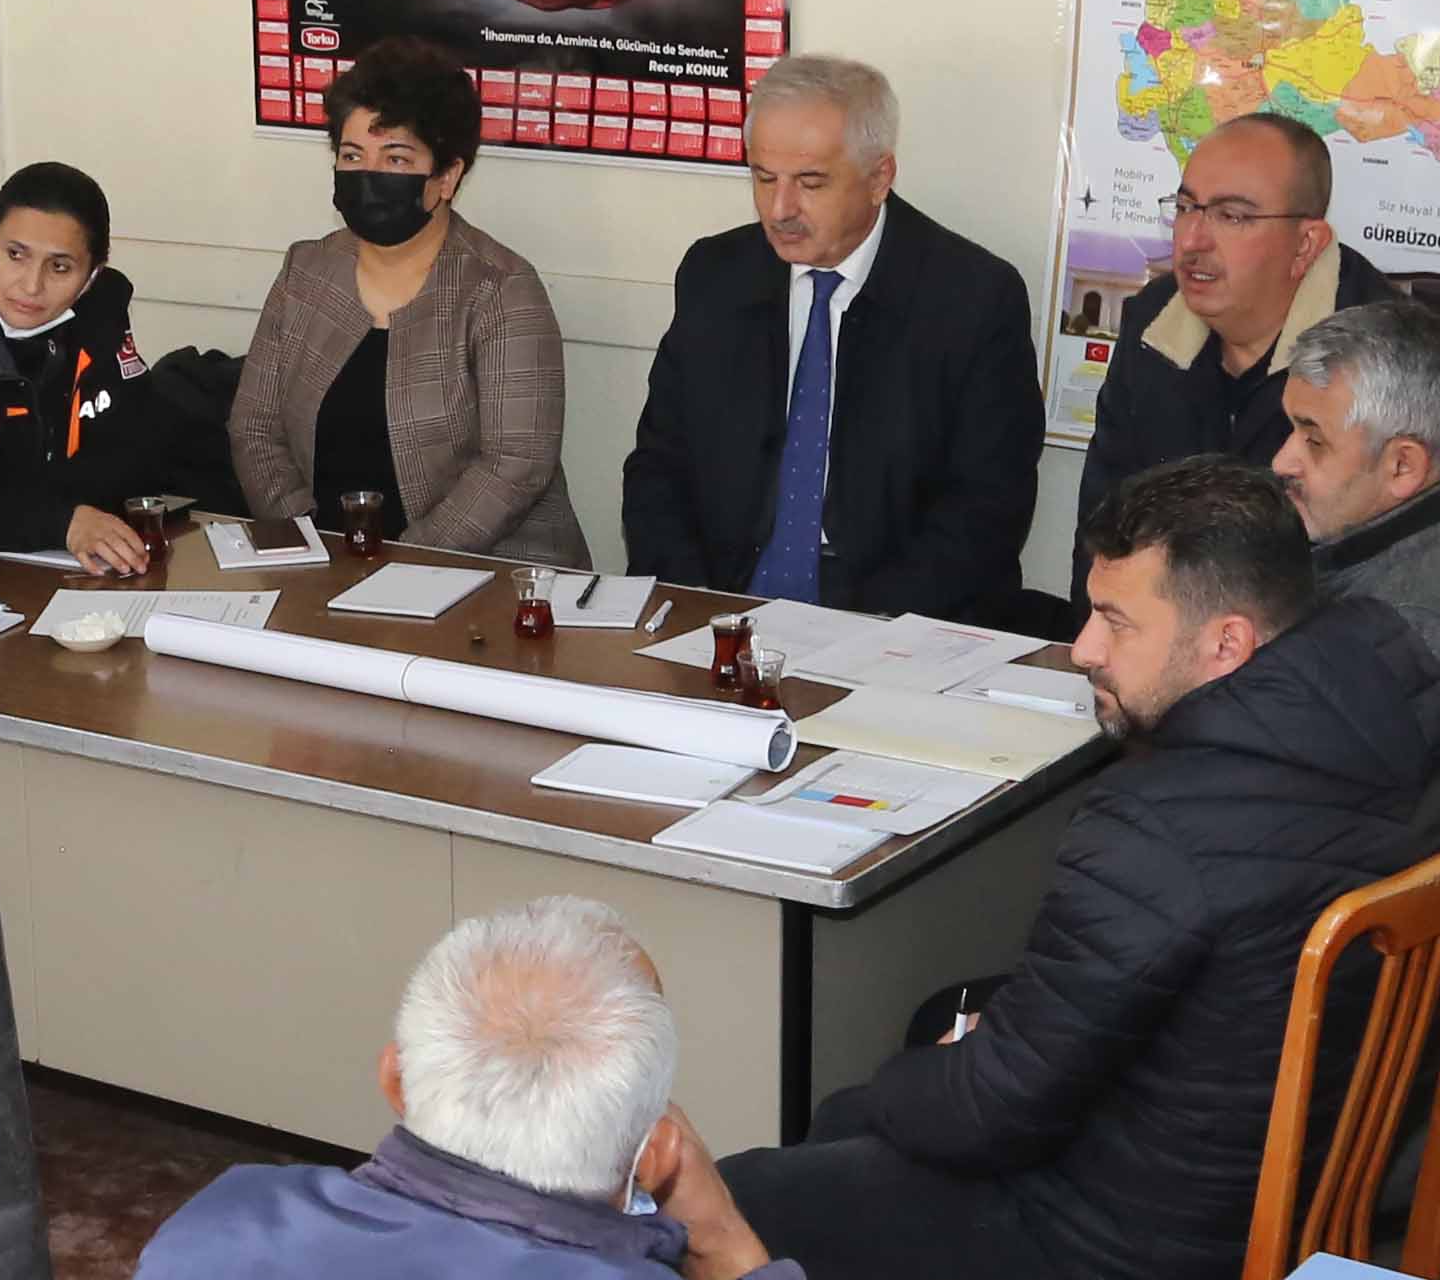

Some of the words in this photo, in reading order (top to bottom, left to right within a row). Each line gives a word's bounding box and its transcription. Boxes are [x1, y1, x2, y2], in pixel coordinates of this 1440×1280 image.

[616, 38, 661, 55] Gücümüz
[649, 60, 683, 76] Recep
[686, 63, 729, 78] KONUK
[1400, 202, 1433, 218] Hayal
